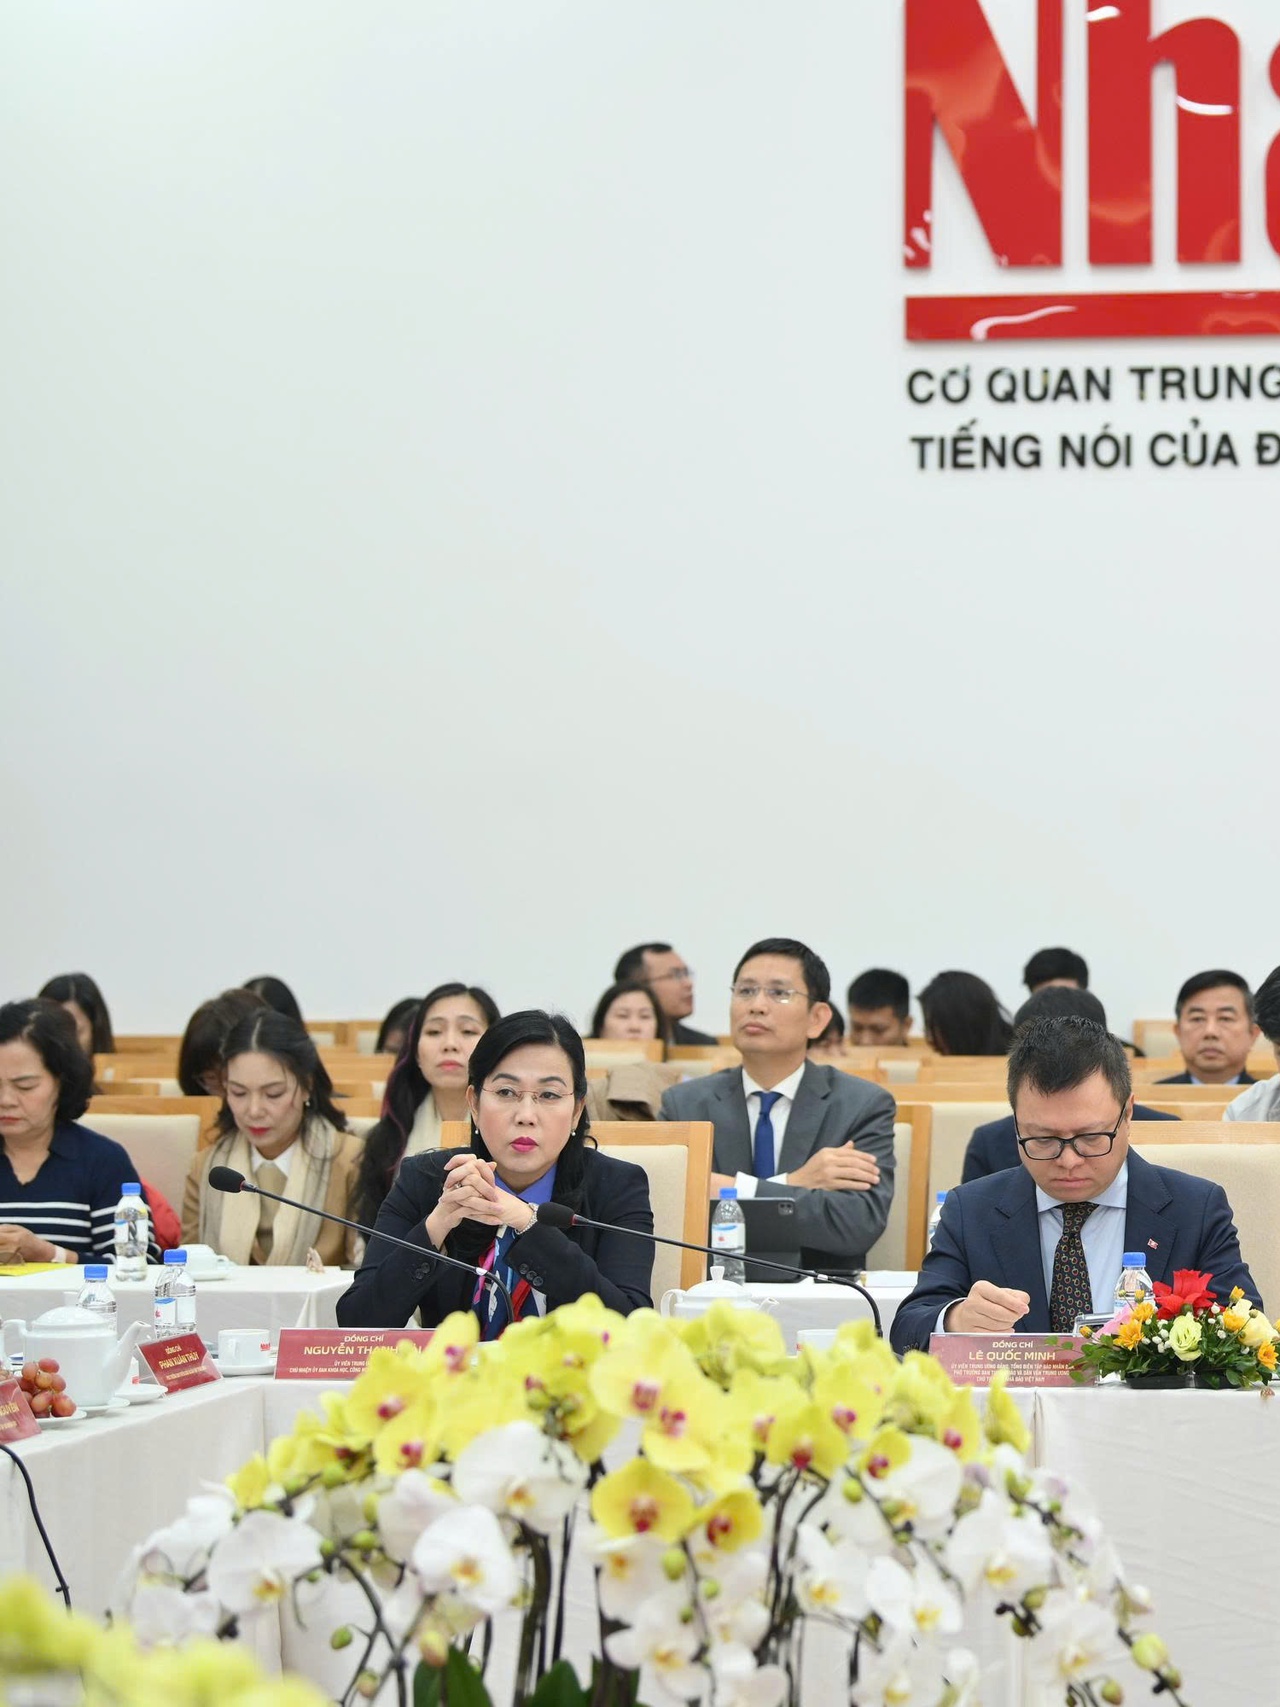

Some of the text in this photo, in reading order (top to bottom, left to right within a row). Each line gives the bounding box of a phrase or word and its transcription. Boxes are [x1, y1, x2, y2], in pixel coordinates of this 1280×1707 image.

[907, 365, 971, 403] CƠ
[987, 368, 1111, 404] QUAN
[910, 420, 1042, 469] TIẾNG
[1060, 425, 1132, 468] NÓI
[1149, 419, 1239, 467] CỦA
[303, 1342, 355, 1355] NGUYỄN
[968, 1349, 1056, 1362] LÊ QUỐC MINH
